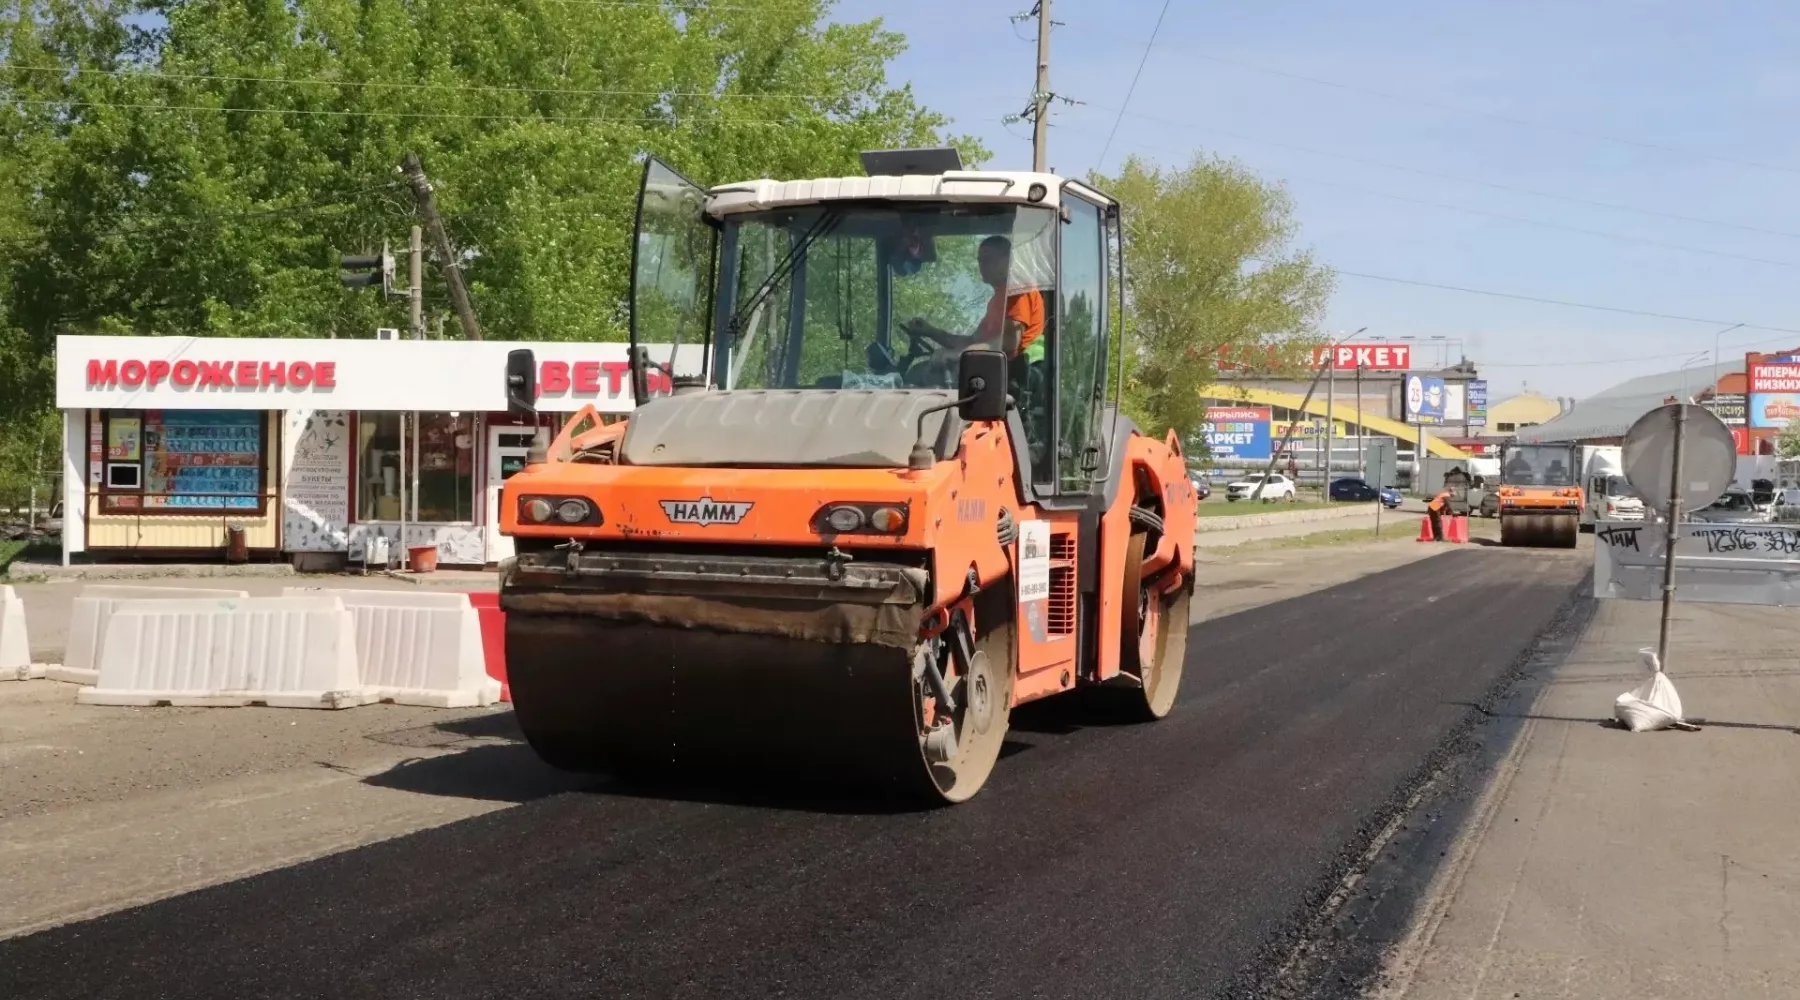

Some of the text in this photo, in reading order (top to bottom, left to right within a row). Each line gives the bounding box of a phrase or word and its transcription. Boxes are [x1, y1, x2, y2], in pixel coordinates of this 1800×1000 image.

[87, 359, 337, 388] МОРОЖЕНОЕ
[533, 360, 673, 398] ВЕТЫ
[1202, 411, 1260, 419] ТКРЫЛИСЬ
[1204, 433, 1254, 445] АРКЕТ
[673, 503, 736, 520] HAMM
[958, 499, 986, 522] HAMM
